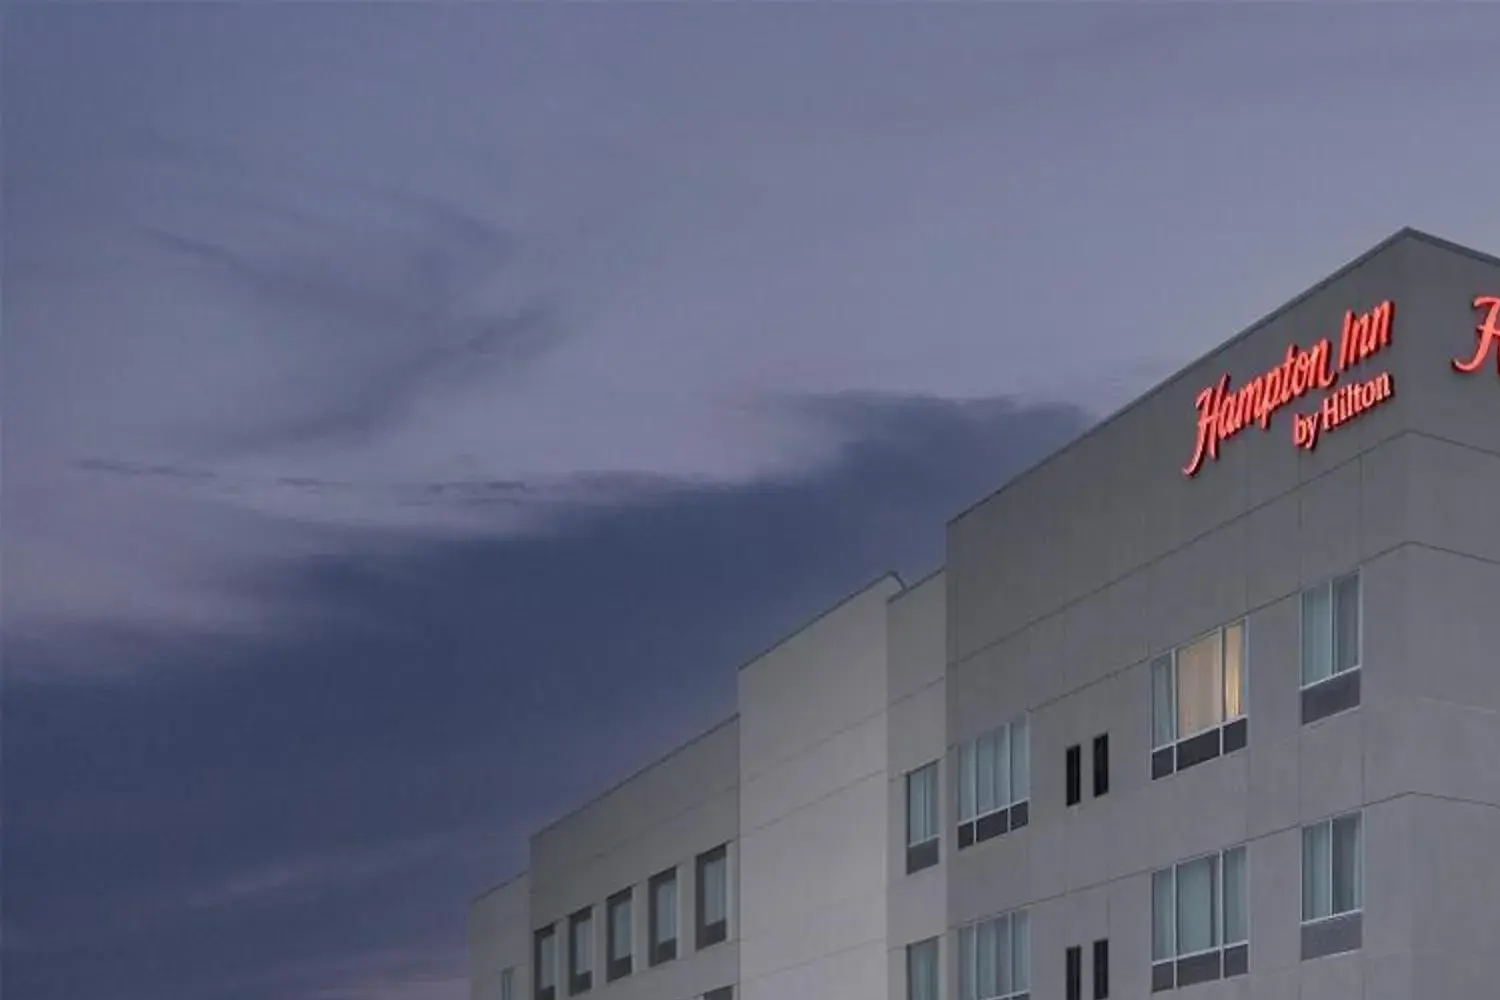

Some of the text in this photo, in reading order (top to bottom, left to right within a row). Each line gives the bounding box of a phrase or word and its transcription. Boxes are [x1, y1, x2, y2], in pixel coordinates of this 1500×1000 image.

[1182, 301, 1394, 476] Hampton Inn
[1294, 371, 1393, 451] by Hilton
